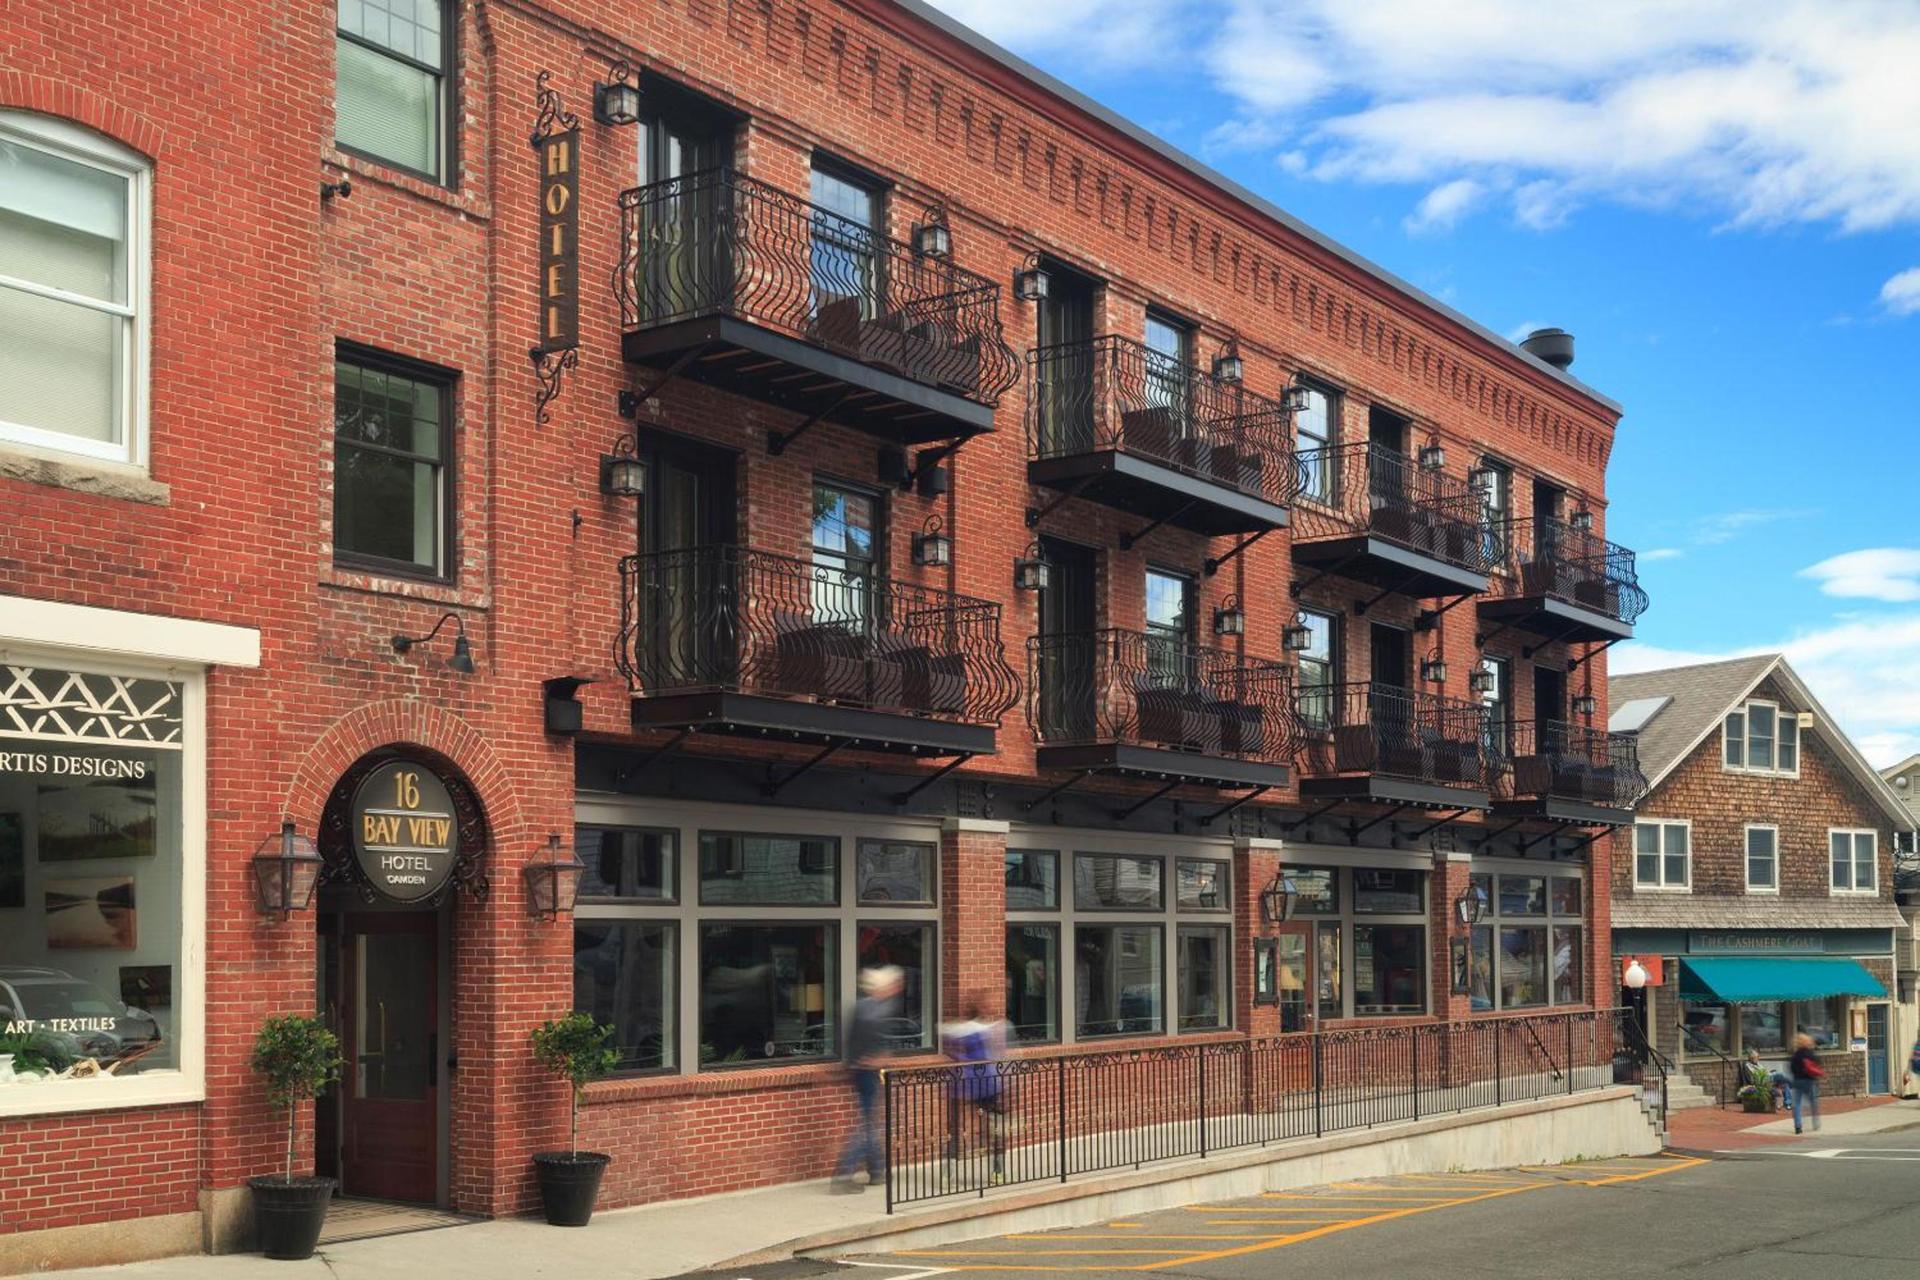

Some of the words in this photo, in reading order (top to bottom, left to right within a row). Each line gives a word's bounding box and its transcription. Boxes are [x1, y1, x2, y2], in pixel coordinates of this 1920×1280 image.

[546, 141, 570, 338] HOTEL
[0, 752, 47, 772] RTIS
[52, 755, 145, 779] DESIGNS
[394, 771, 420, 809] 16
[363, 815, 402, 844] BAY
[408, 818, 450, 846] VIEW
[382, 856, 432, 871] HOTEL
[387, 874, 426, 884] CAMDEN
[1701, 934, 1724, 948] THE
[1726, 934, 1784, 949] CASHMERE
[5, 1019, 35, 1034] ART
[51, 1017, 116, 1032] TEXTILES
